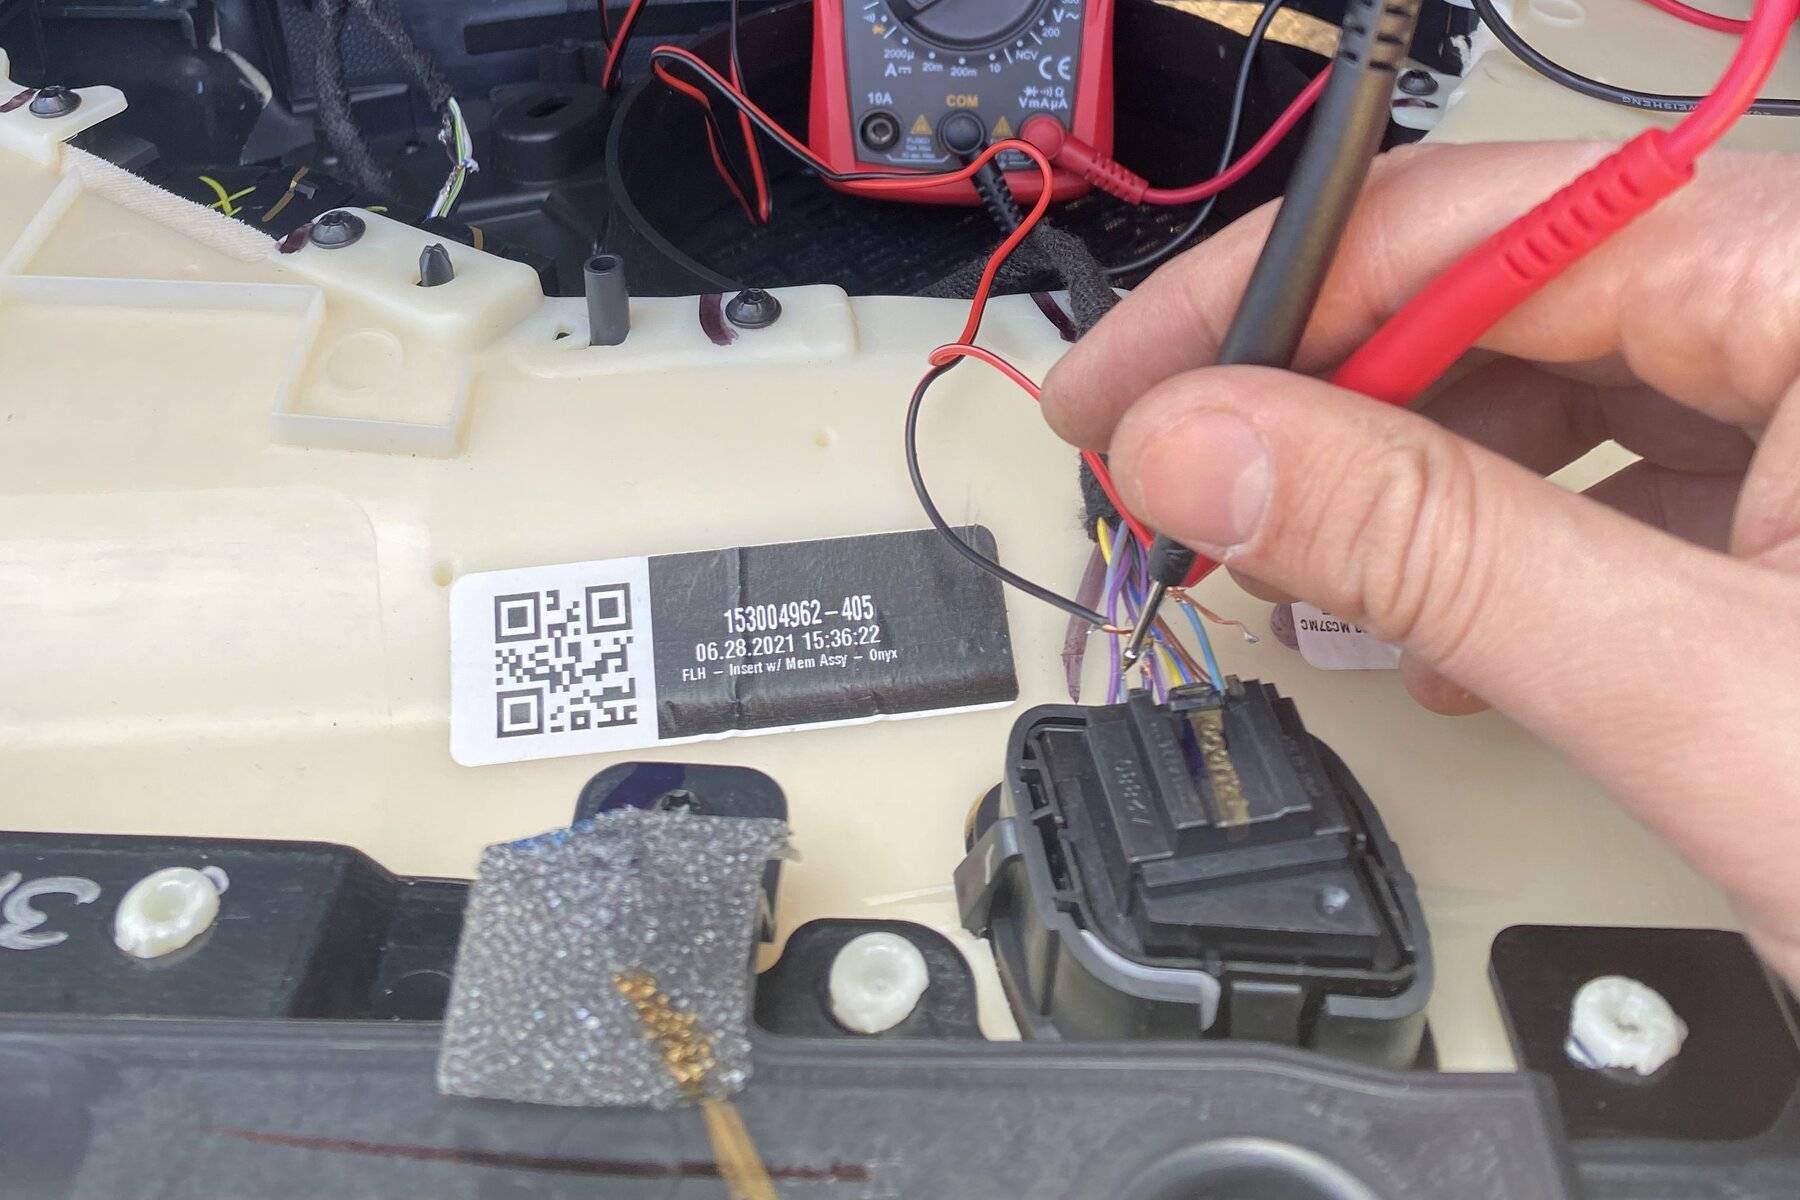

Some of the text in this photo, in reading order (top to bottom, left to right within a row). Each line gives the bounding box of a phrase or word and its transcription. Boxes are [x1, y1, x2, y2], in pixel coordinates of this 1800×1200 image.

[1042, 28, 1060, 37] 200
[1016, 50, 1038, 60] NCV
[922, 63, 943, 72] 20m
[951, 66, 977, 76] 200m
[989, 64, 1001, 73] 10
[1039, 56, 1071, 80] CE
[868, 92, 893, 105] 10A
[946, 95, 979, 107] COM
[695, 625, 881, 662] 06.28.2021 15:36:22
[682, 667, 707, 682] FLH
[729, 663, 764, 676] Insert
[766, 661, 782, 672] w/
[786, 657, 816, 670] Mem
[819, 653, 848, 669] Assy
[869, 649, 898, 664] Onyx
